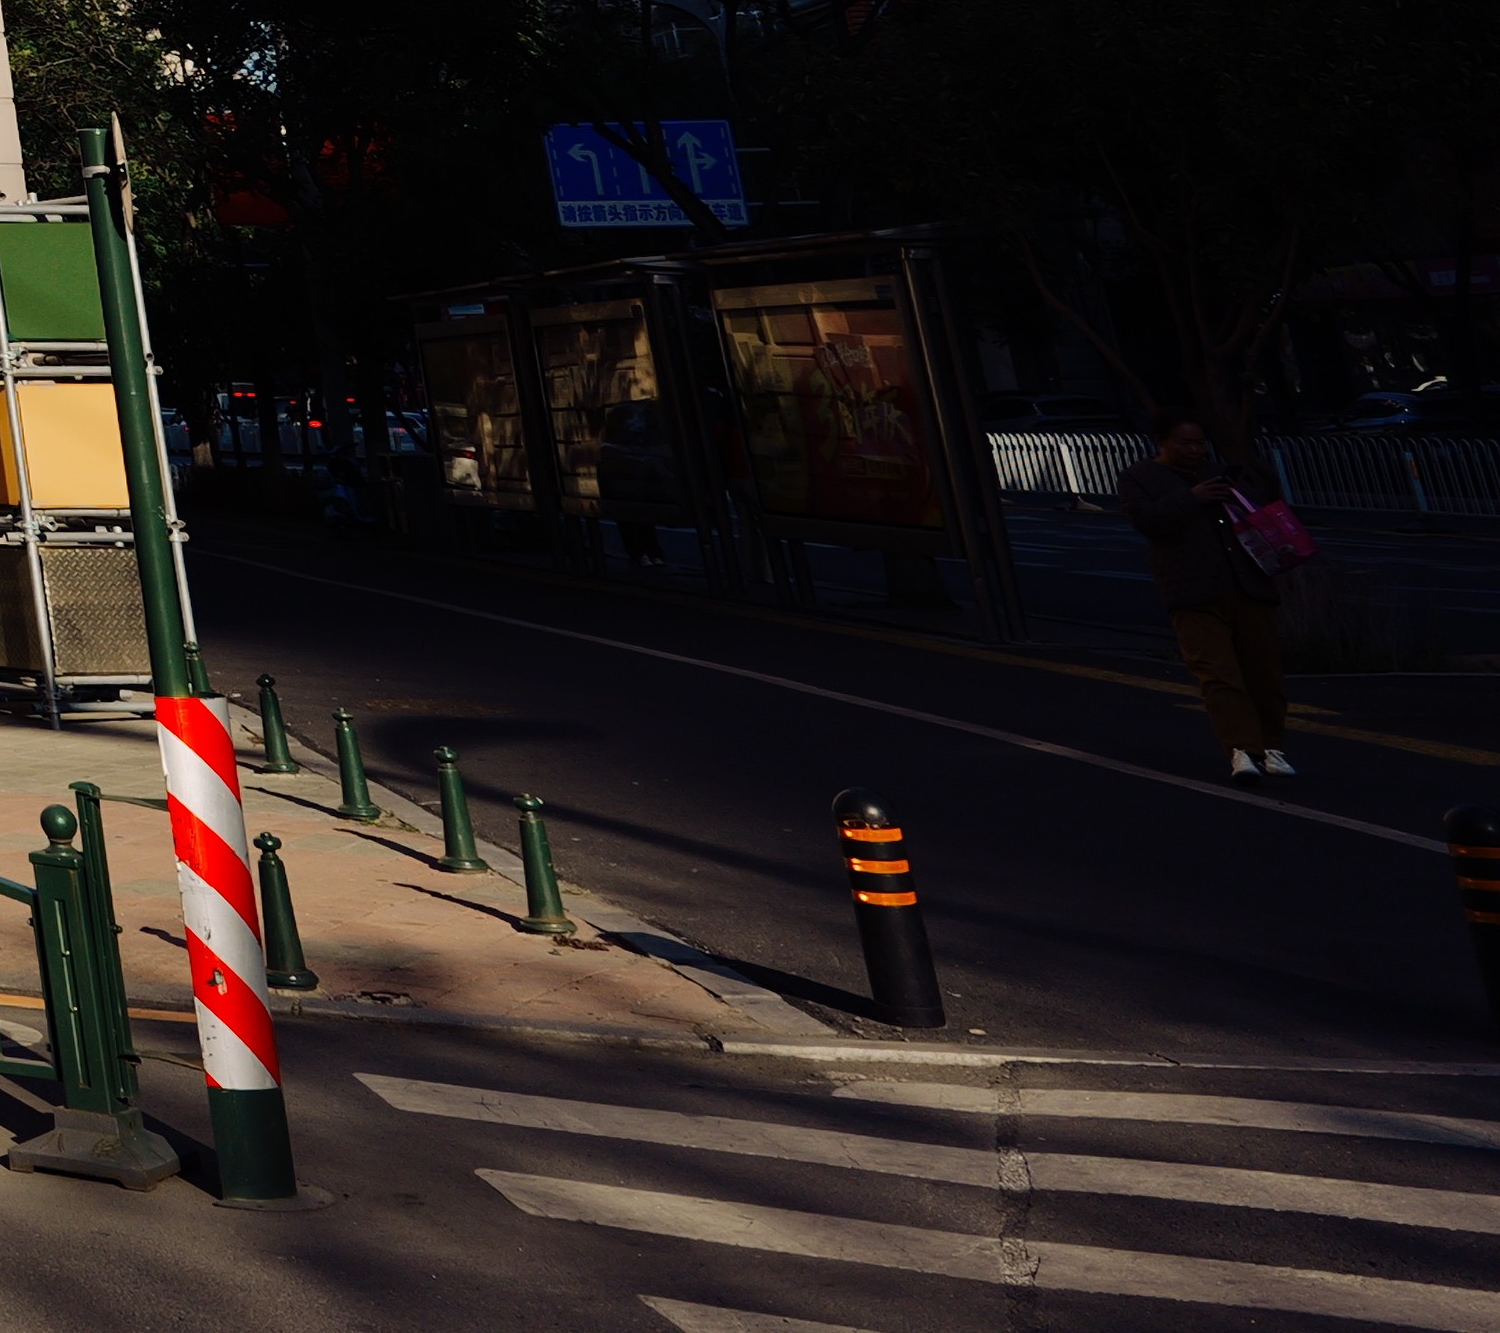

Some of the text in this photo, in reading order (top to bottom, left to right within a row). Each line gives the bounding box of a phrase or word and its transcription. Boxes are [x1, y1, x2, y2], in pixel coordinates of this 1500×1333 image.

[562, 203, 745, 223] 请按箭头指示方向车道
